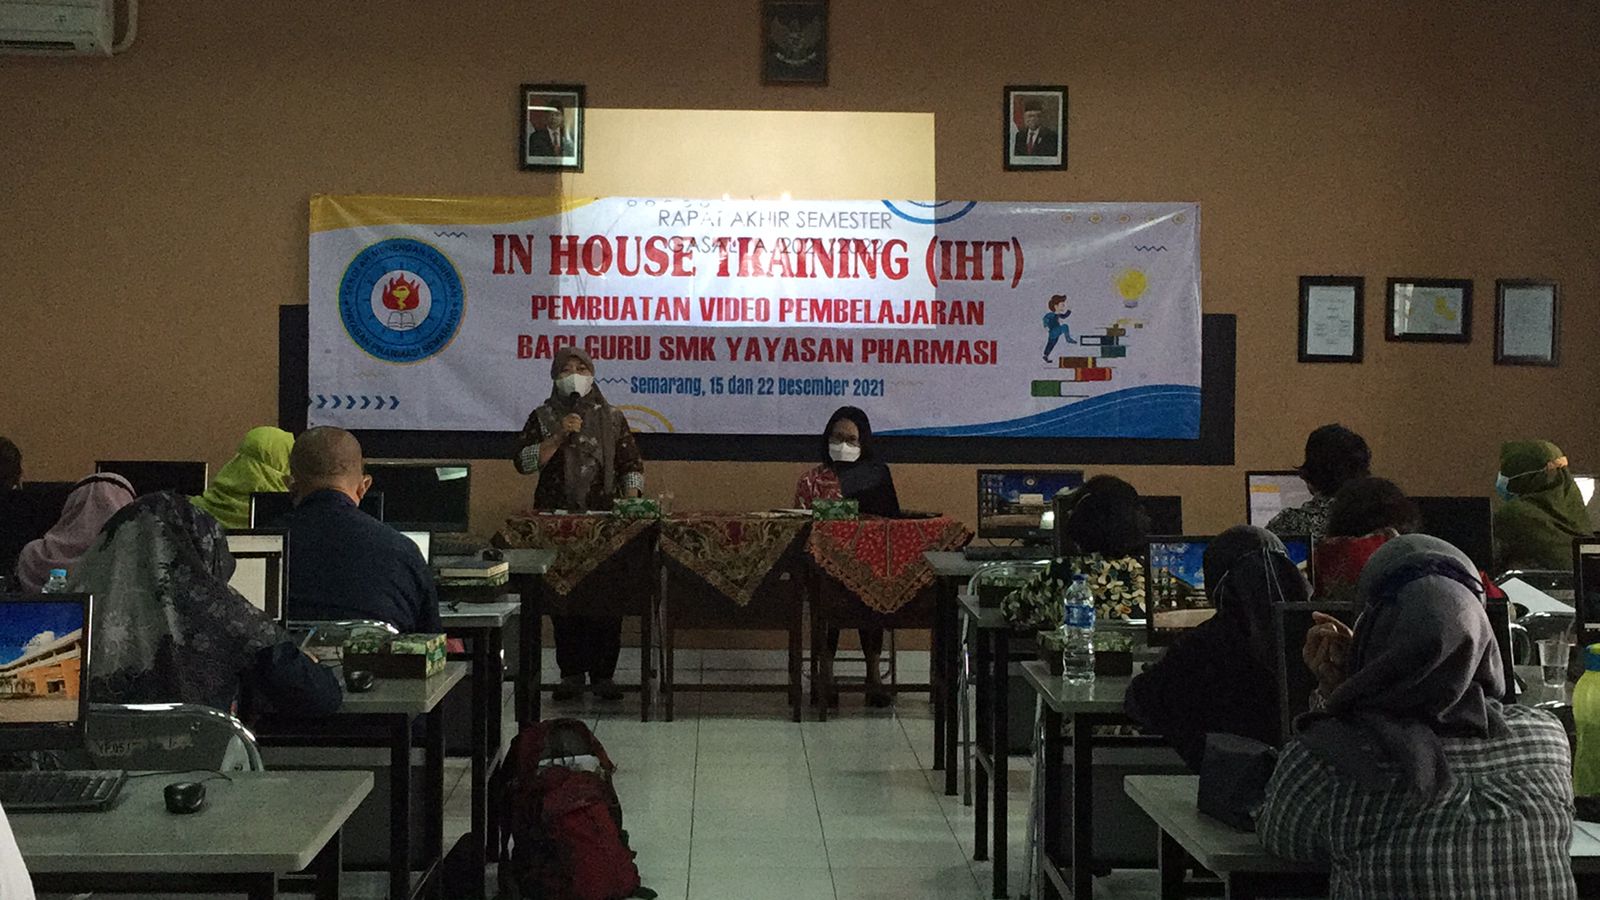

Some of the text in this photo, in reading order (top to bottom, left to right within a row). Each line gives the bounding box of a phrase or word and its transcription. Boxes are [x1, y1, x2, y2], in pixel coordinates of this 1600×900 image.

[796, 210, 892, 229] SEMESTER
[492, 234, 1024, 289] IN HOUSE TRAINING (IHT)
[531, 295, 985, 326] PEMBUATAN VIDEO PEMBELAJARAN
[585, 335, 651, 360] GURU
[659, 336, 716, 361] SMK
[725, 337, 853, 363] YAYASAN
[861, 339, 998, 366] PHARMASI
[630, 375, 885, 397] Semarang, 15 dan 22 Desember 2021
